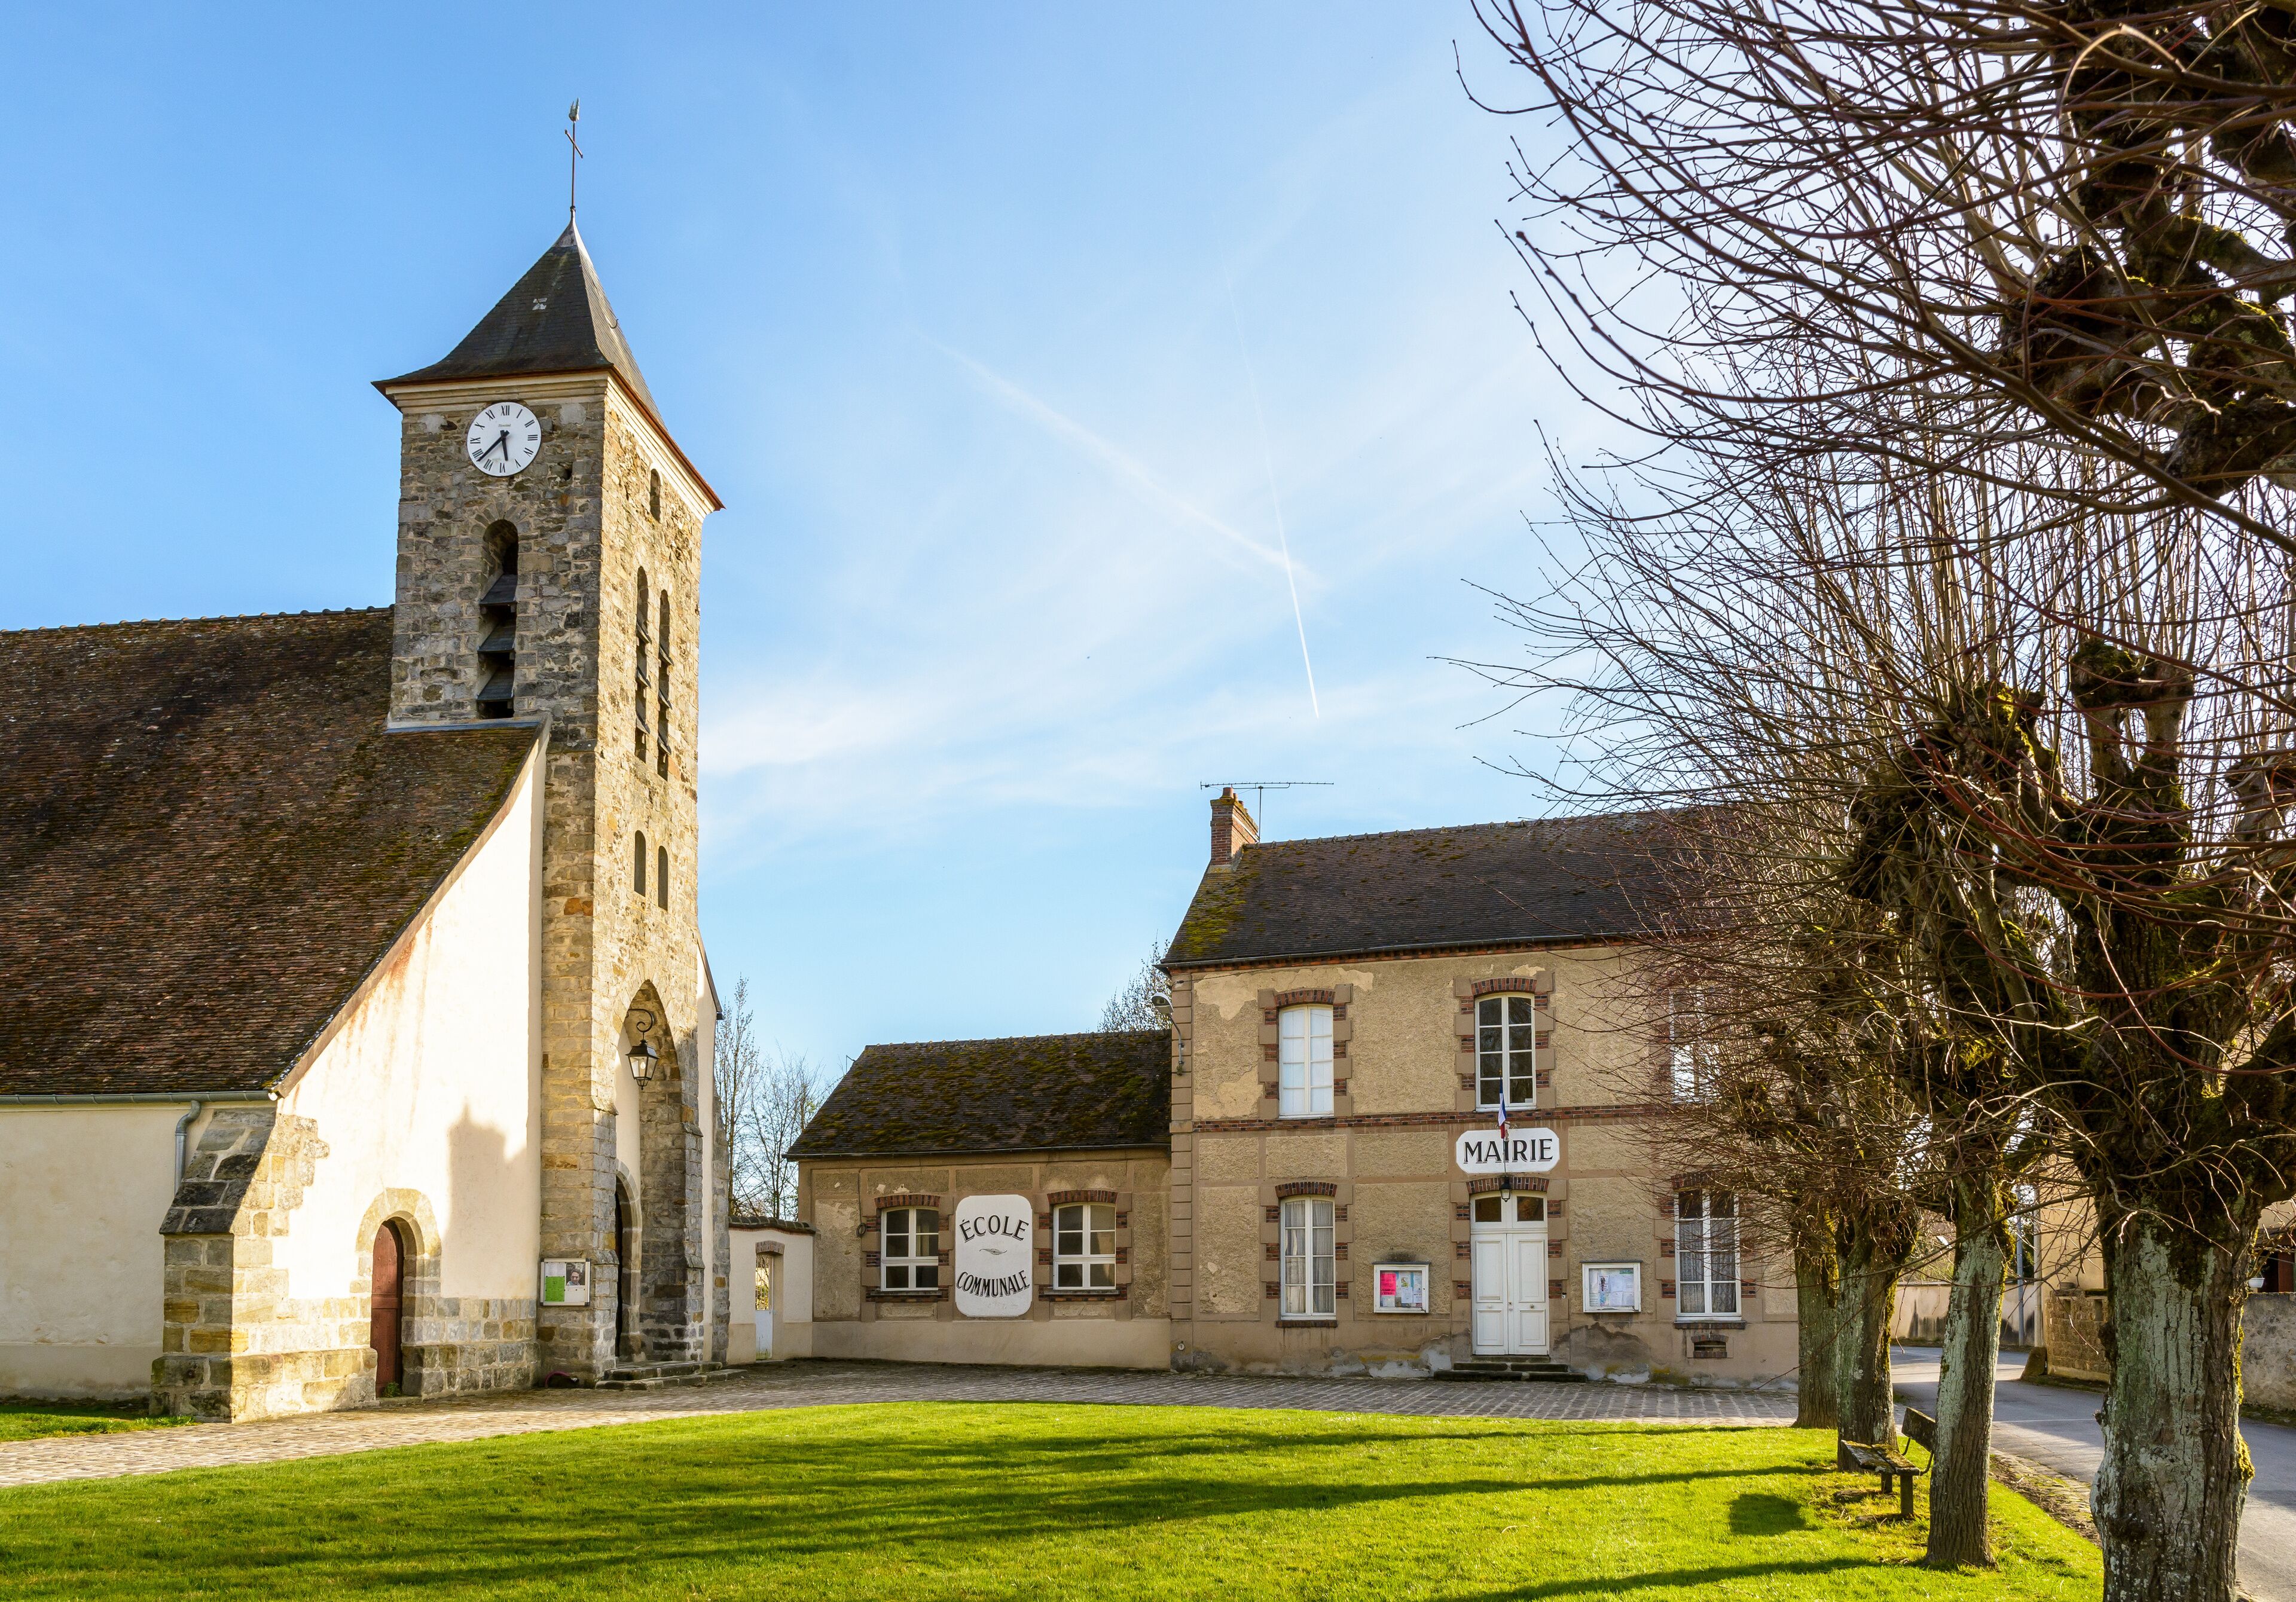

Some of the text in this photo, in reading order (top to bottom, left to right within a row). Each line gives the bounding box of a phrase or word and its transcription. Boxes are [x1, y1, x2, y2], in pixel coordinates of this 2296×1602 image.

[485, 409, 495, 421] XI
[501, 405, 509, 416] XII
[516, 409, 523, 418] I
[524, 420, 535, 428] II
[523, 447, 534, 457] IV
[483, 458, 493, 471] VII
[499, 463, 505, 473] VI
[514, 458, 521, 469] V
[1464, 1139, 1553, 1164] MAIRIE
[959, 1215, 1029, 1243] ÉCOLE
[957, 1270, 1030, 1298] COMMUNALE
